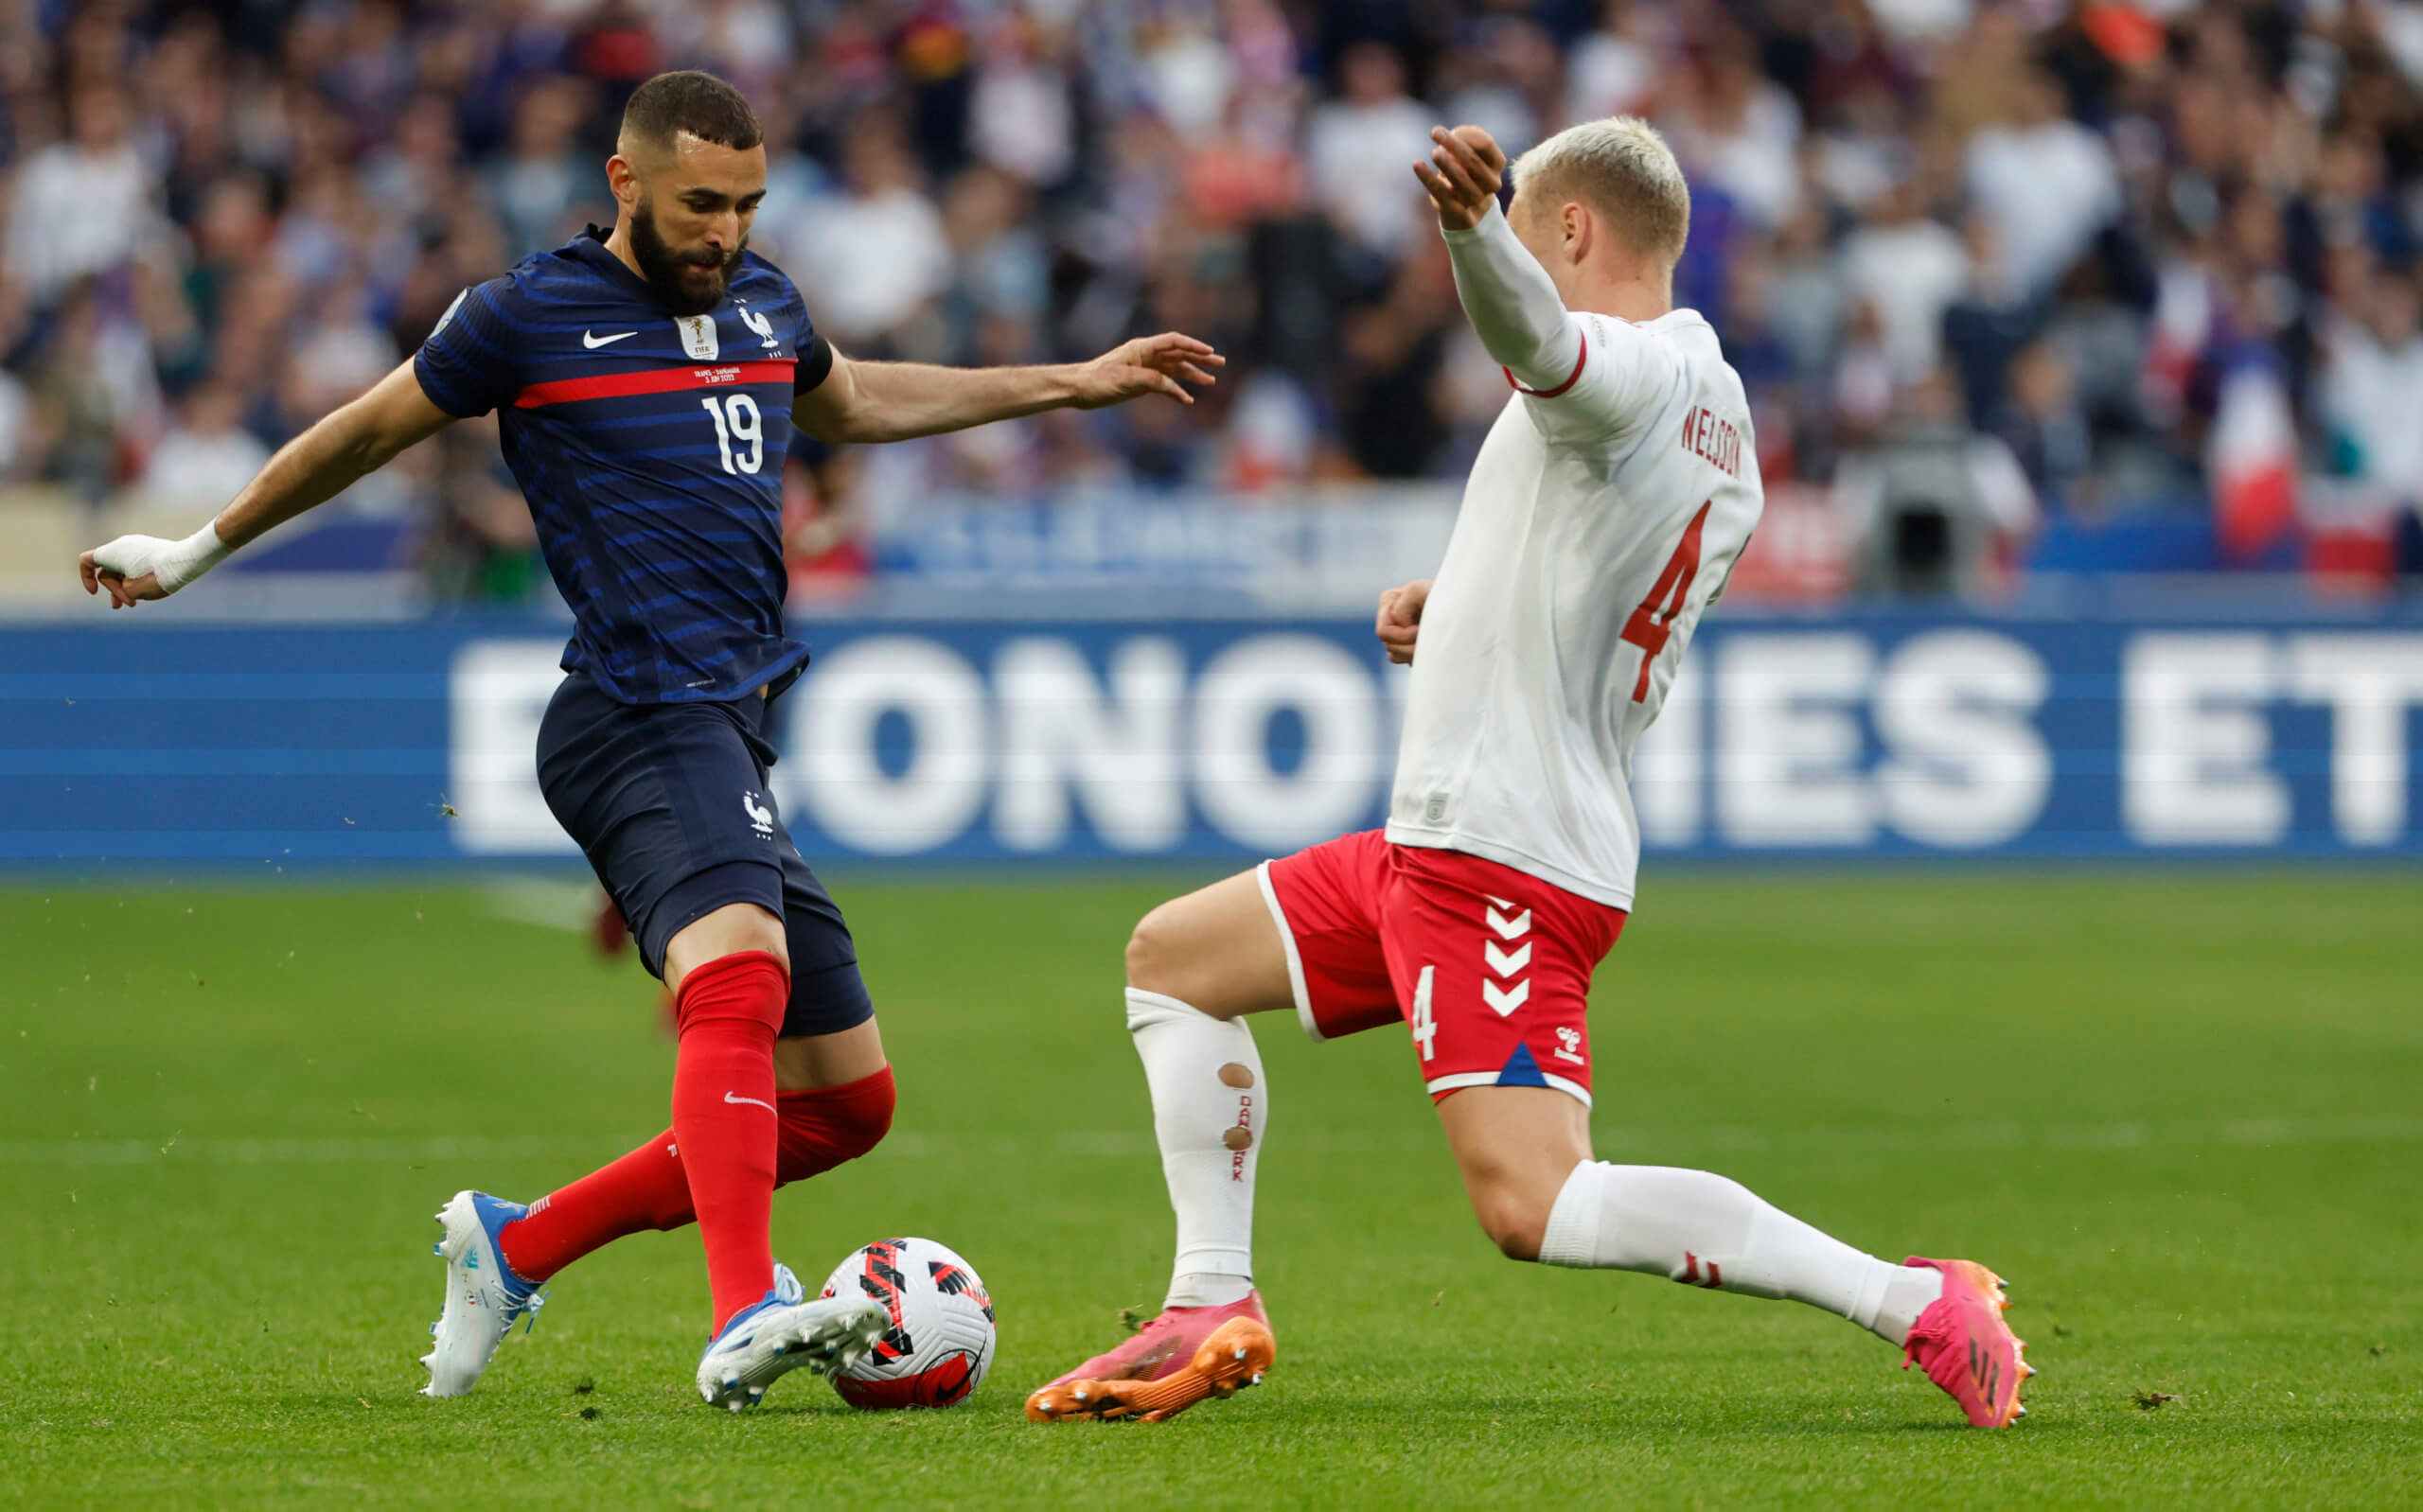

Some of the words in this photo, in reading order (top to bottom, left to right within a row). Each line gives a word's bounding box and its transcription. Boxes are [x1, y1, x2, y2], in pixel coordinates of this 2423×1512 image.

[701, 393, 763, 475] 19
[1681, 405, 1741, 481] NELSSON
[1619, 499, 1711, 703] 4
[2123, 632, 2423, 846] ET
[1412, 965, 1437, 1062] 4
